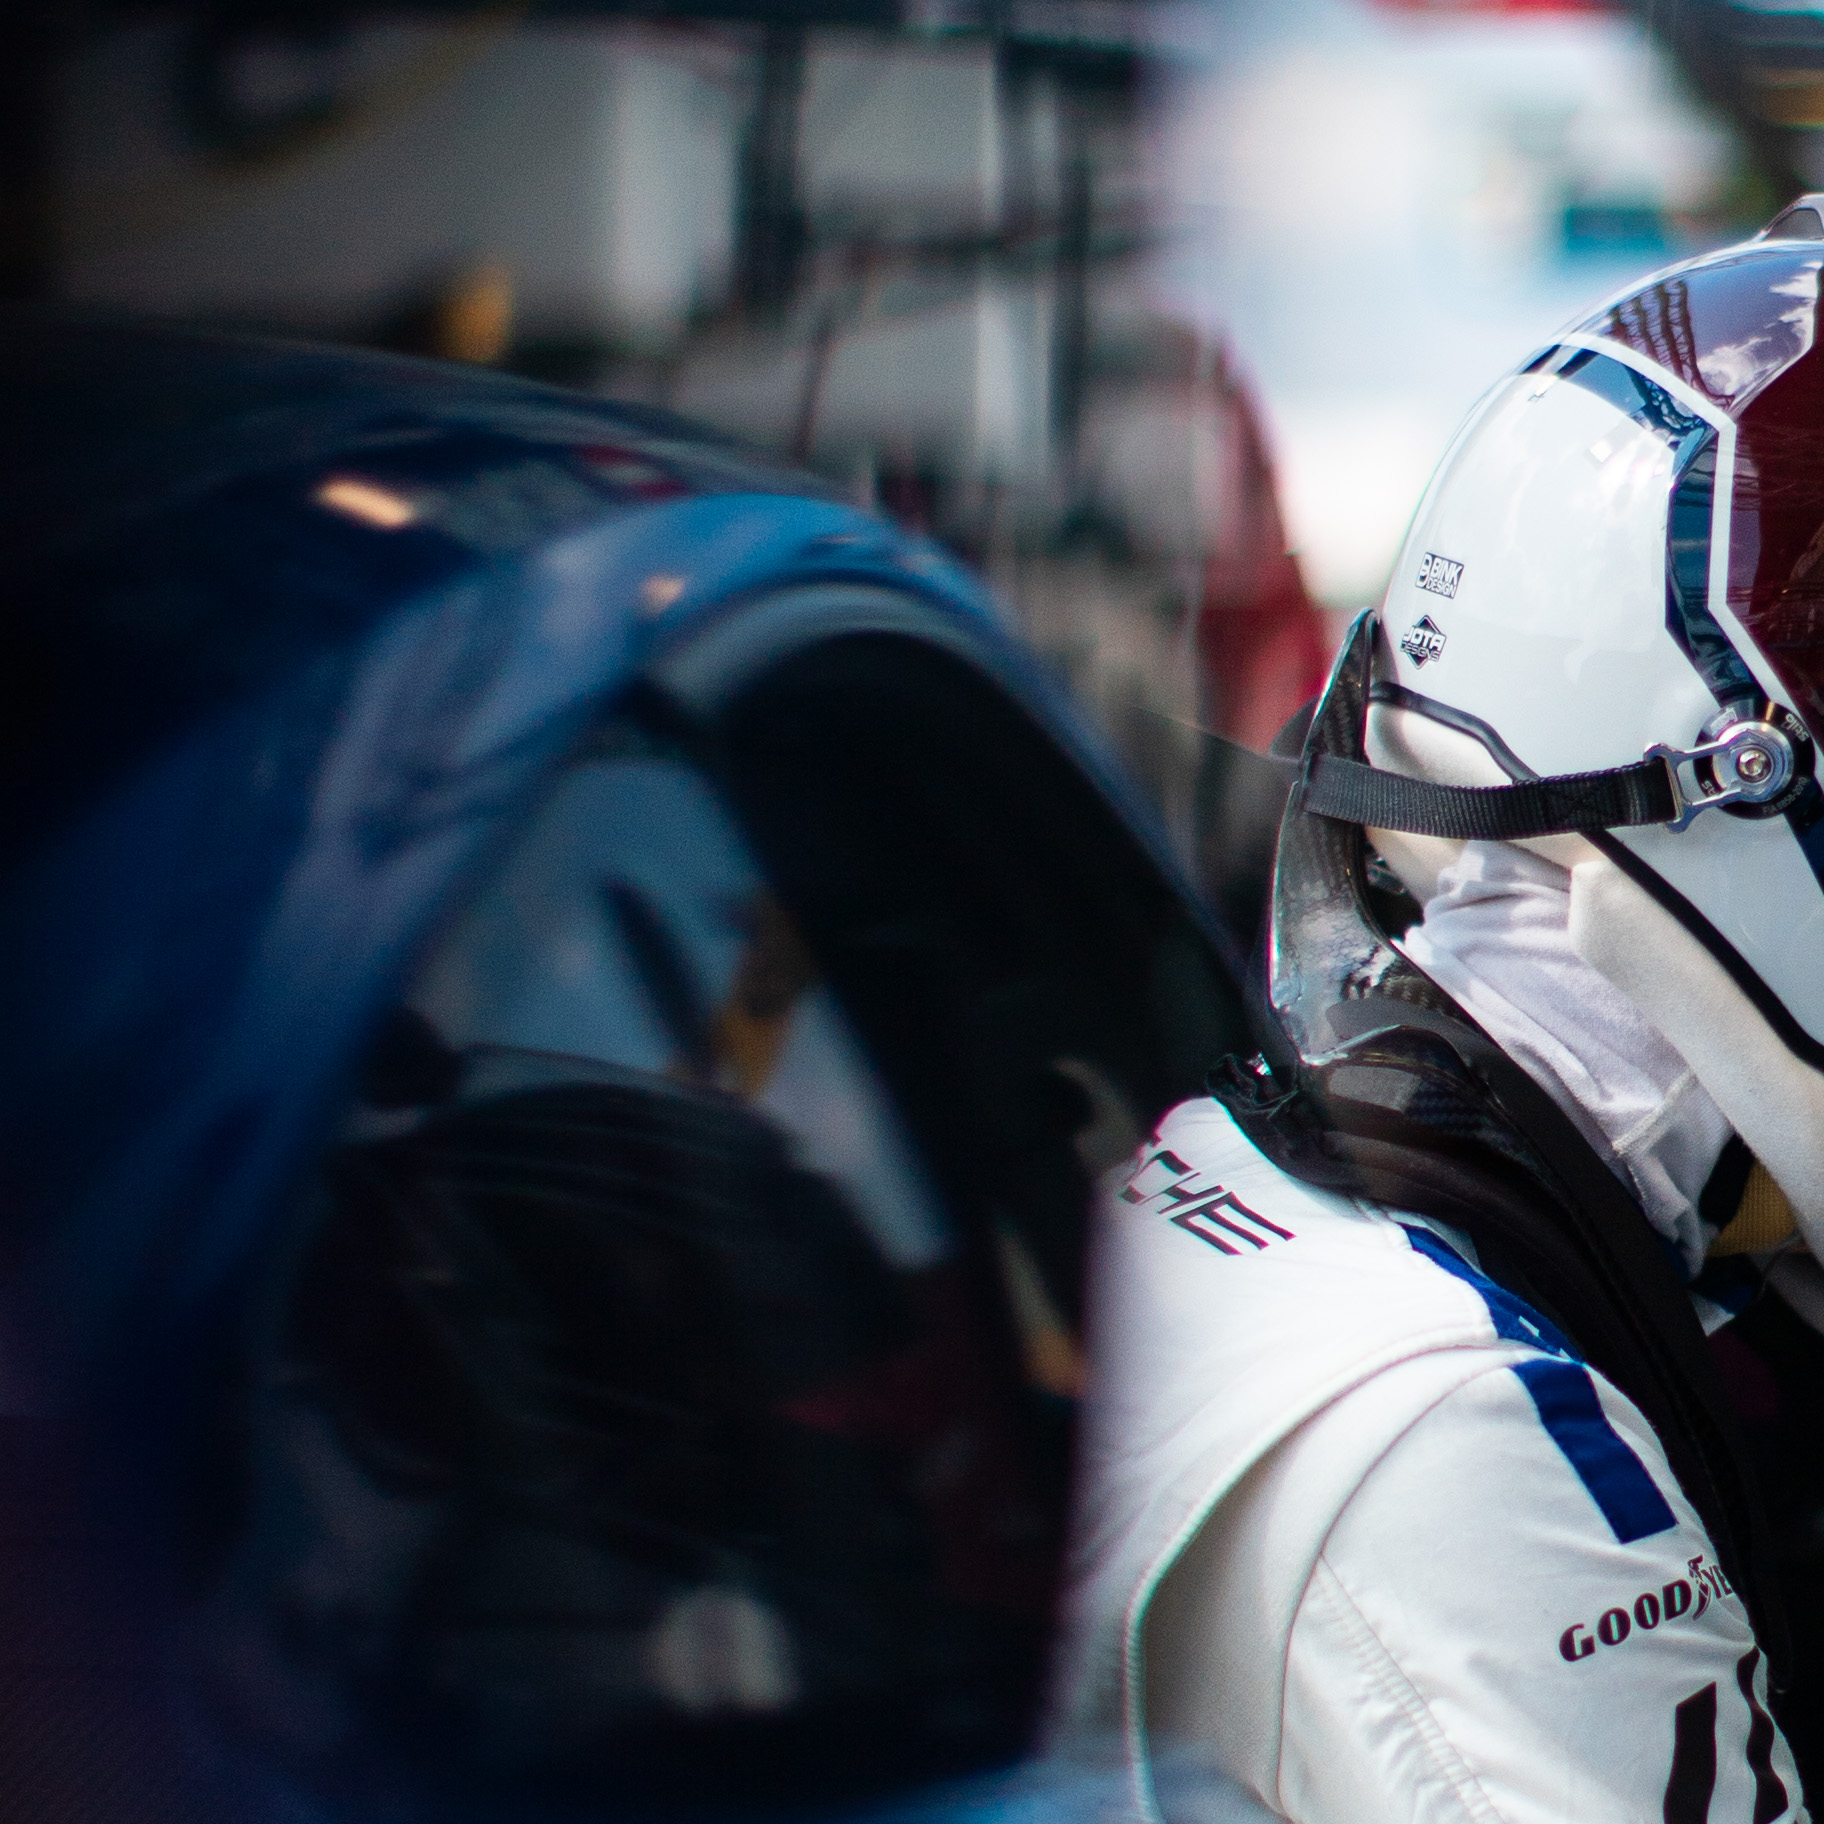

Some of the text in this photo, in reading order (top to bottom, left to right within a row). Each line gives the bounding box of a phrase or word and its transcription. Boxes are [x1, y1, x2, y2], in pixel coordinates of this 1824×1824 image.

[1430, 557, 1462, 586] BINK
[1426, 577, 1457, 597] DESIGN
[1403, 627, 1446, 651] JOTA
